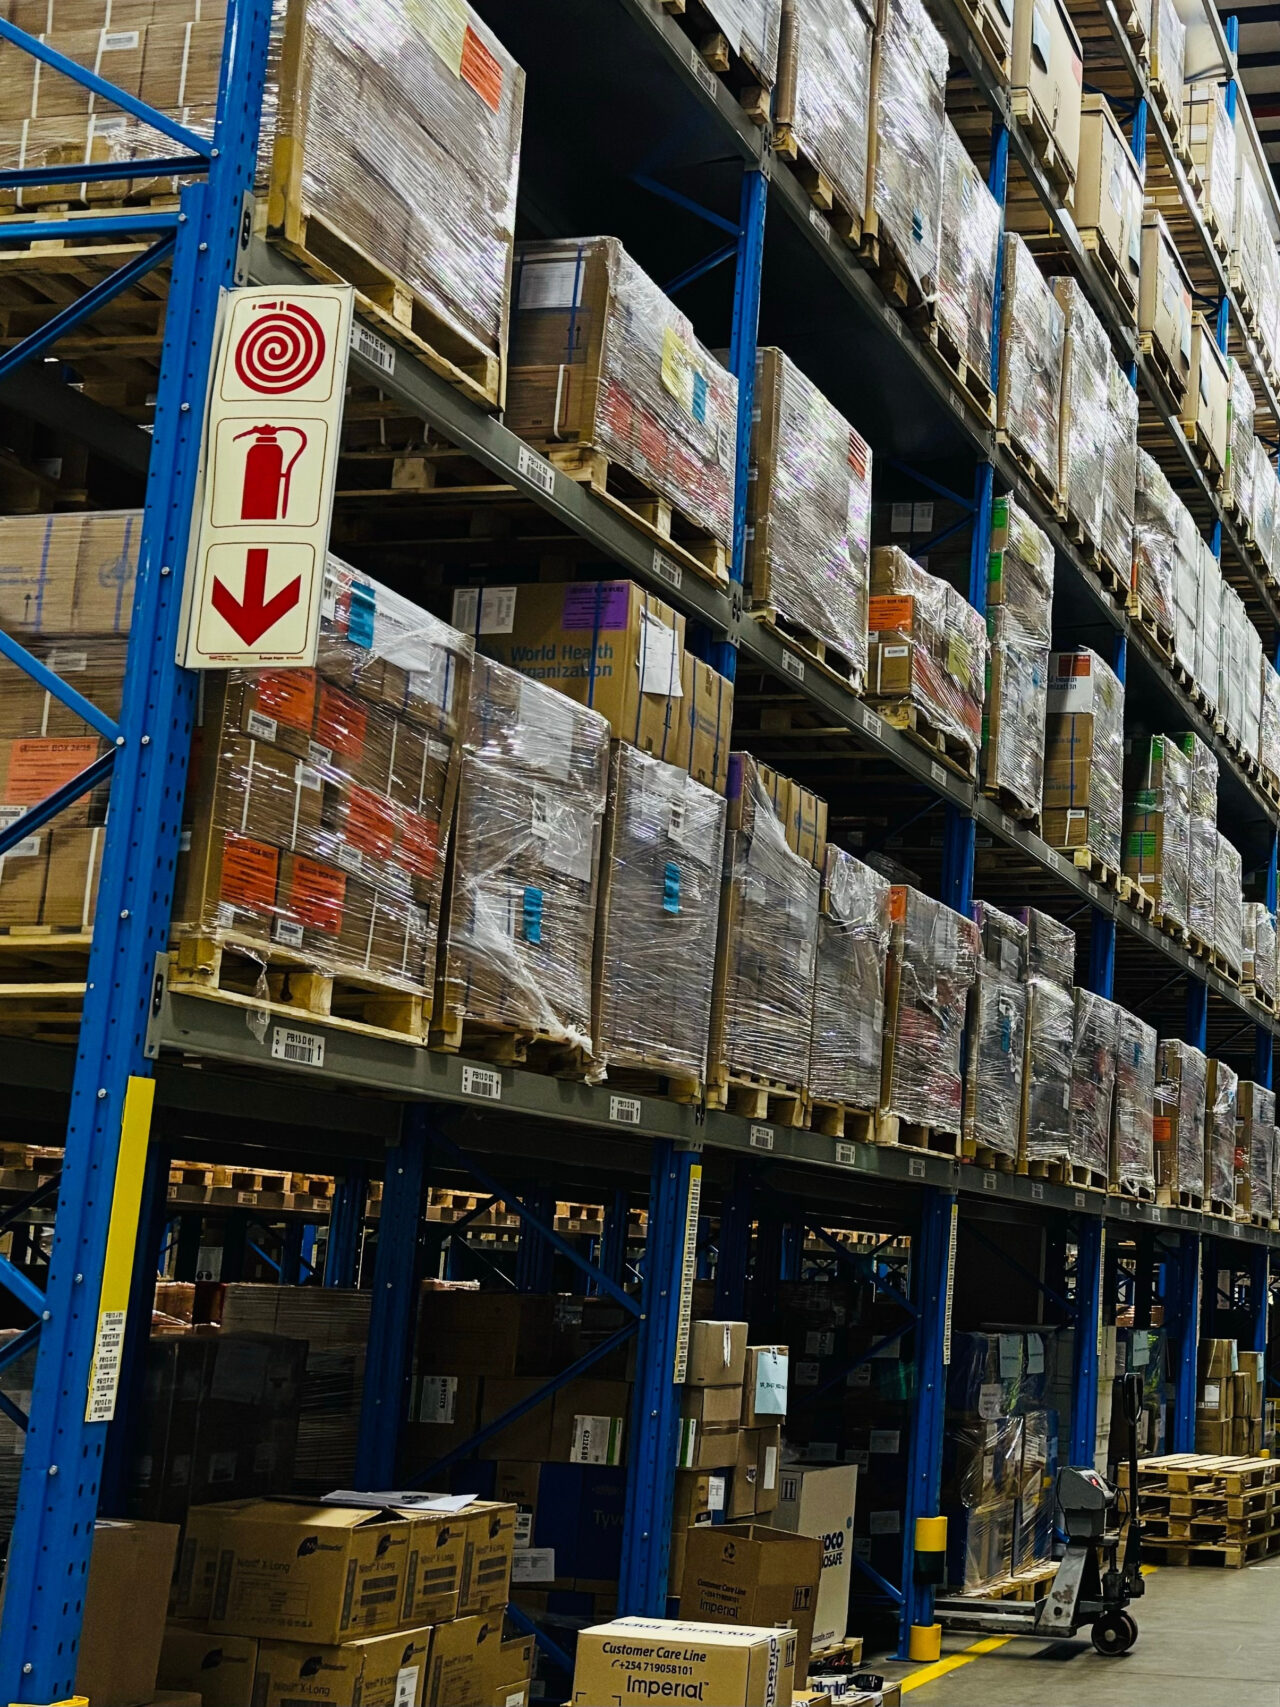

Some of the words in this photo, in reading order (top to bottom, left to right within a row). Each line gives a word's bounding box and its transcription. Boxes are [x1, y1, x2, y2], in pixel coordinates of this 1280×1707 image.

[511, 644, 557, 663] World
[561, 641, 614, 661] Heath
[817, 1530, 844, 1552] OCO
[821, 1551, 844, 1569] OSAFE
[700, 1598, 739, 1620] Imperial
[602, 1641, 655, 1659] Customer
[656, 1647, 682, 1661] Care
[682, 1649, 707, 1663] Line
[618, 1660, 642, 1672] +254
[643, 1661, 694, 1676] 719058101
